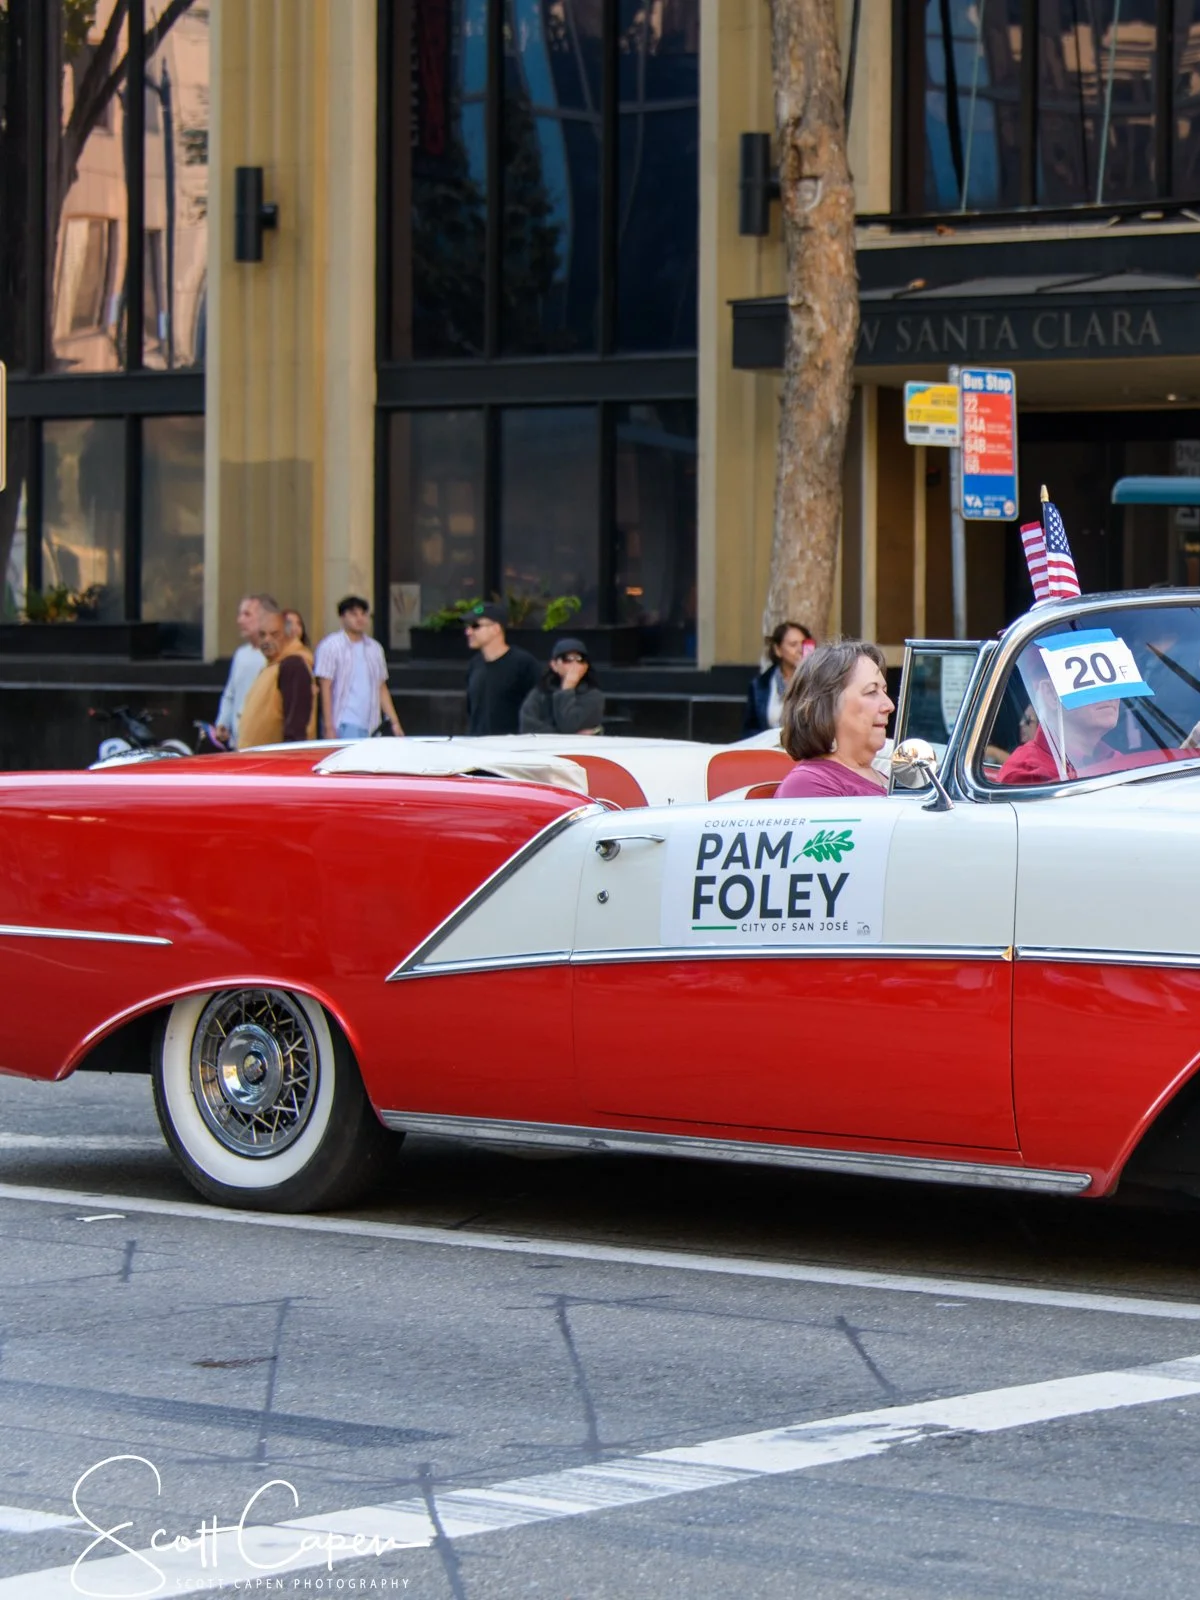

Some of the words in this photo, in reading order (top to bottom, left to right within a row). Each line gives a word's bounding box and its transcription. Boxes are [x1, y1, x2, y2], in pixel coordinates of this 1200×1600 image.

[896, 314, 1018, 353] SANTA
[1032, 309, 1162, 349] CLARA
[963, 373, 984, 390] Bus
[986, 374, 1012, 395] Stop
[1064, 652, 1117, 690] 20
[704, 818, 806, 828] COUNCILMEMBER
[696, 831, 793, 870] PAM
[692, 873, 850, 920] FOLEY
[741, 923, 766, 932] CITY
[772, 922, 786, 931] OF
[792, 922, 814, 931] SAN
